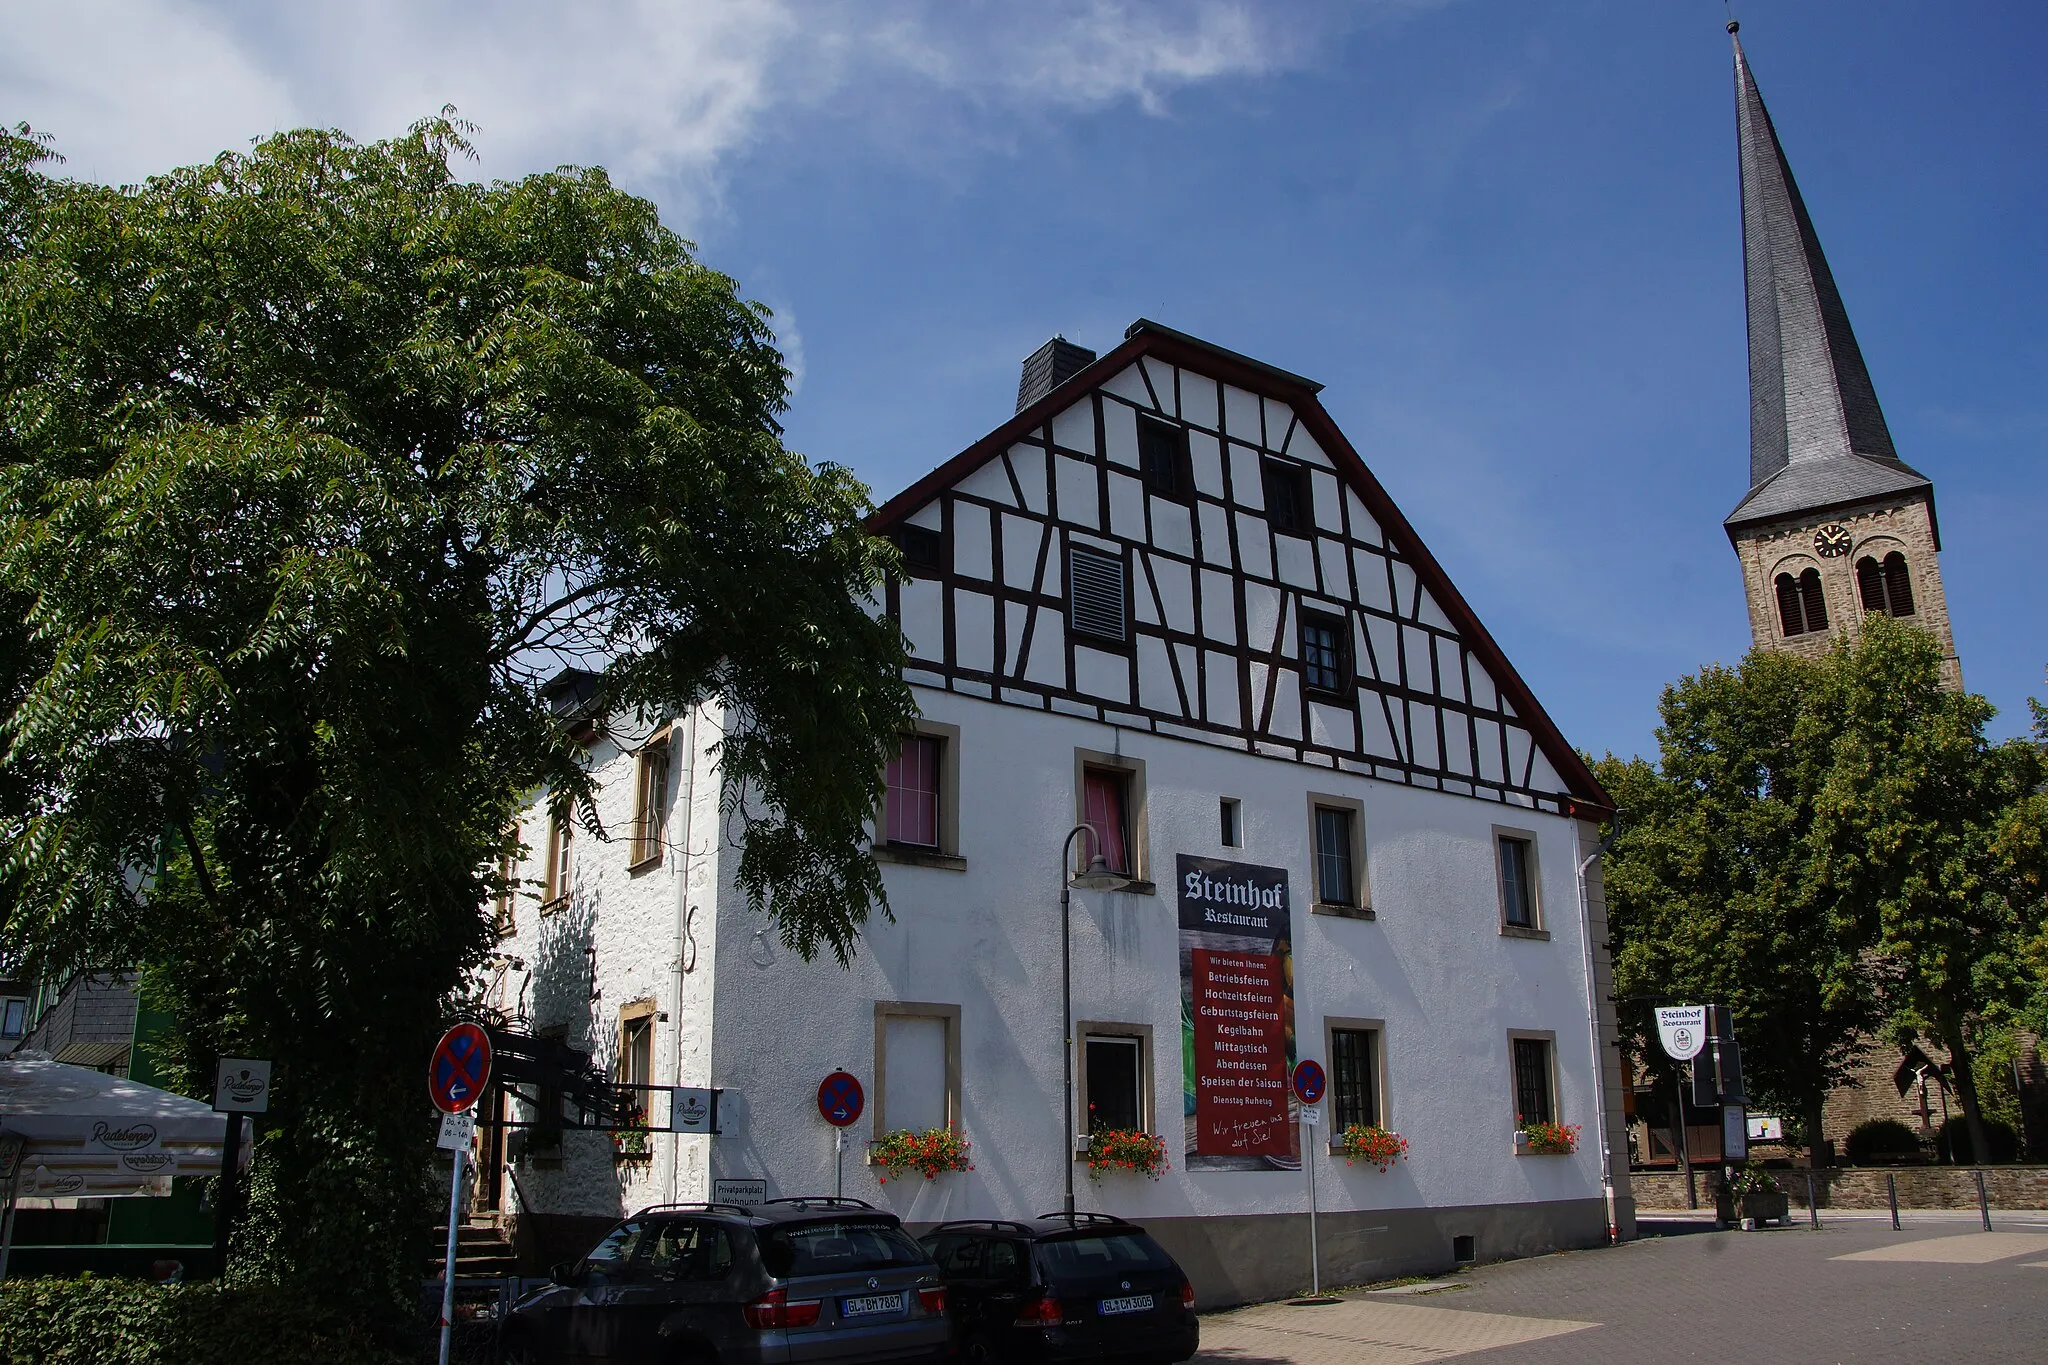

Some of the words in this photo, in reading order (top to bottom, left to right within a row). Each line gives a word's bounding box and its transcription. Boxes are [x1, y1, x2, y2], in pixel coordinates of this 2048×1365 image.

[1185, 869, 1283, 911] Steinhof
[1204, 907, 1268, 928] Restaurant
[1209, 956, 1221, 965] Wir
[1222, 957, 1244, 967] bieten
[1245, 960, 1267, 969] Ihnen:
[1208, 971, 1269, 986] Betriebsfeiern
[1205, 988, 1273, 1003] Hochzeitsfeiern
[1200, 1005, 1279, 1020] Geburtstagsfeiern
[1661, 1009, 1702, 1019] Steinhof
[1217, 1024, 1264, 1037] Kegelbahn
[1662, 1019, 1702, 1027] Restaurant
[1214, 1041, 1268, 1054] Mittagstisch
[1216, 1058, 1267, 1071] Abendessen
[1201, 1076, 1236, 1088] Speisen
[1238, 1077, 1254, 1087] der
[1255, 1078, 1282, 1088] Saison
[1213, 1095, 1244, 1106] Dienstag
[1245, 1096, 1273, 1107] Ruhetag
[1213, 1120, 1229, 1135] Wir
[1233, 1119, 1267, 1137] freuen
[1270, 1114, 1283, 1123] uns
[91, 1121, 156, 1148] Radeberger
[1231, 1132, 1249, 1150] auf
[1252, 1127, 1271, 1145] Sie!
[717, 1185, 763, 1196] Privatparkplatz
[848, 1300, 860, 1312] GL
[866, 1298, 878, 1310] BM
[879, 1295, 900, 1308] 7887
[1104, 1301, 1115, 1312] GL
[1120, 1299, 1132, 1310] CM
[1132, 1296, 1152, 1309] 3005
